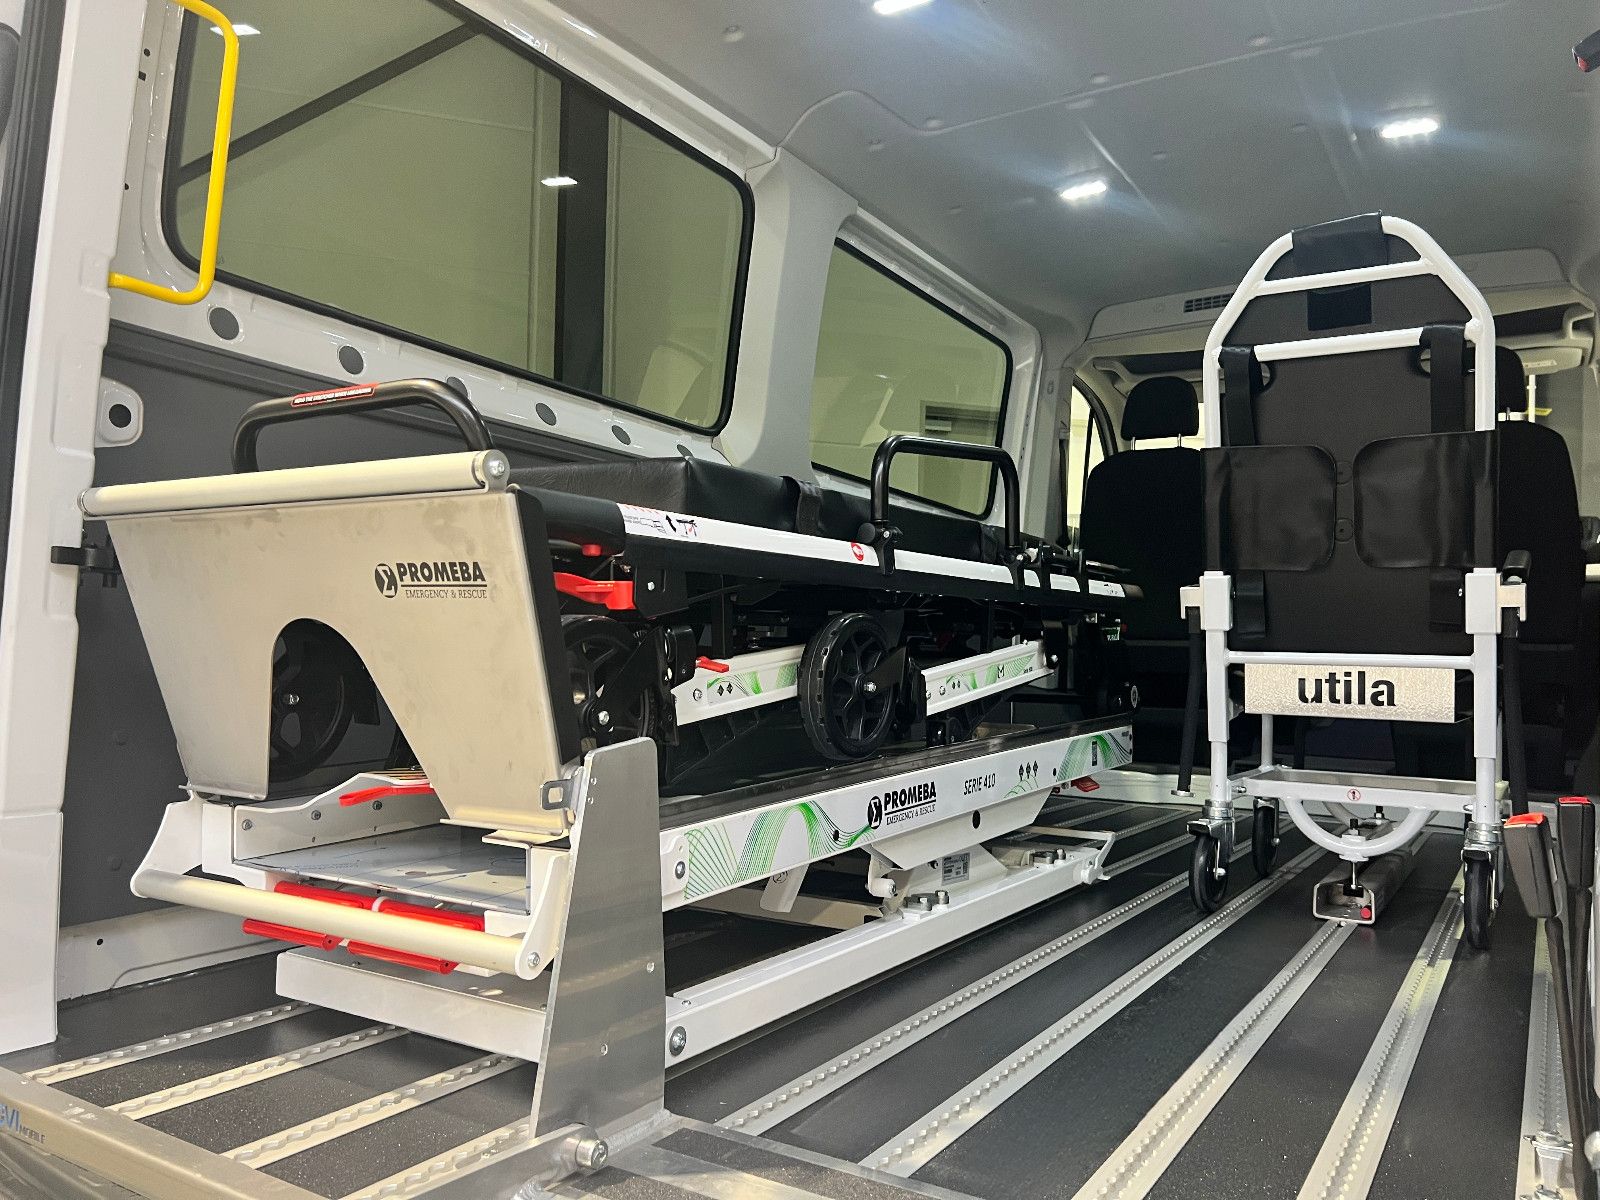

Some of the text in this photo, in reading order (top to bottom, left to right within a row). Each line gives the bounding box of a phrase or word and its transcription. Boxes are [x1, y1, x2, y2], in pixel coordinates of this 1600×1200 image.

[396, 561, 486, 582] PROMEBA
[405, 589, 487, 599] EMERGENCY & RESCUE
[1298, 670, 1396, 707] utila
[884, 781, 937, 811] PROMEBA
[963, 773, 996, 796] SERIE 410
[886, 811, 914, 826] EMERGENCY
[919, 803, 936, 816] RESCUE
